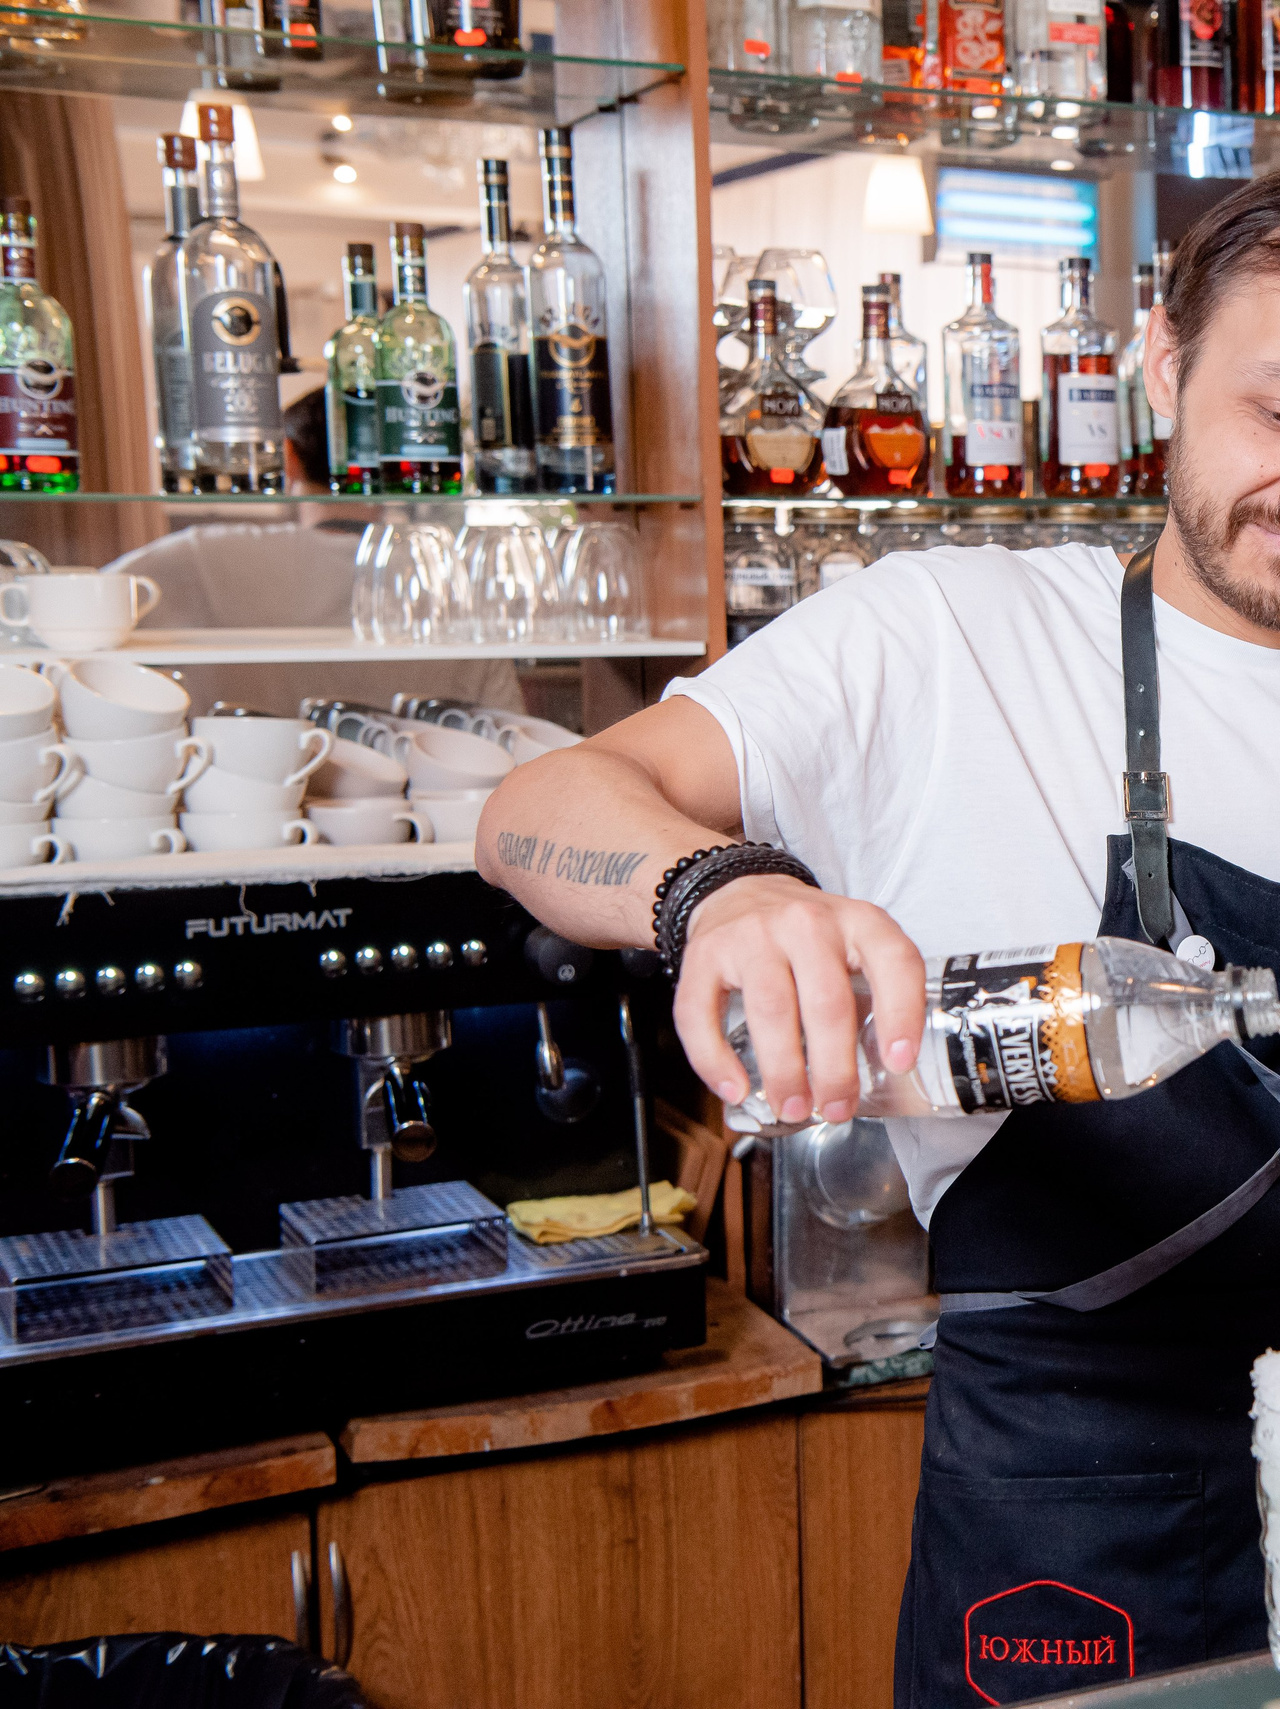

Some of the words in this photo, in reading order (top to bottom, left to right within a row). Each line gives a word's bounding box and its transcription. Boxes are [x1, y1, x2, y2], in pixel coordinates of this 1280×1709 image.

[185, 907, 353, 940] FUTURMAT
[993, 1016, 1046, 1106] EVERVESS
[979, 1634, 1117, 1665] ЮЖНЫЙ
